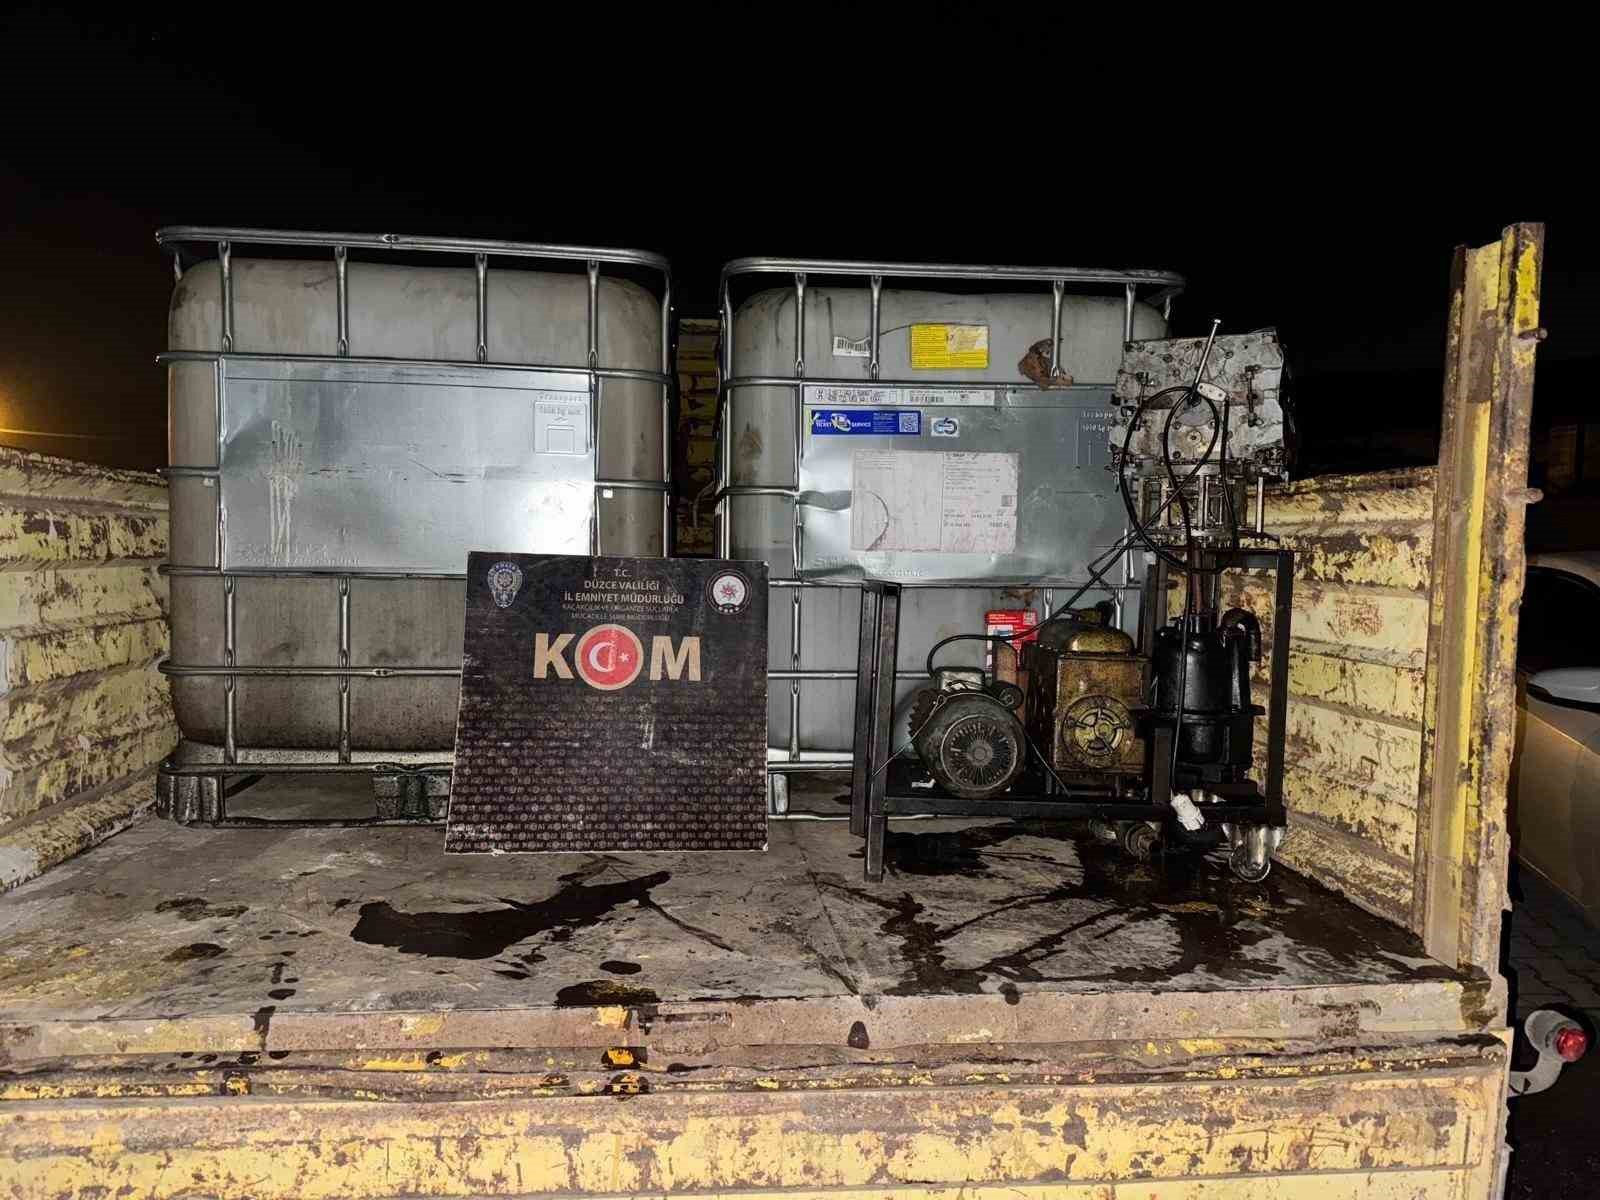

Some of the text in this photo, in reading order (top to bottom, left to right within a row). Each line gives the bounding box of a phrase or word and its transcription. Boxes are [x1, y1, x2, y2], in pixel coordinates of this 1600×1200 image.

[584, 579, 617, 590] DÜZCE
[564, 590, 684, 605] İL EMNİYET MÜDÜRLÜĞÜ
